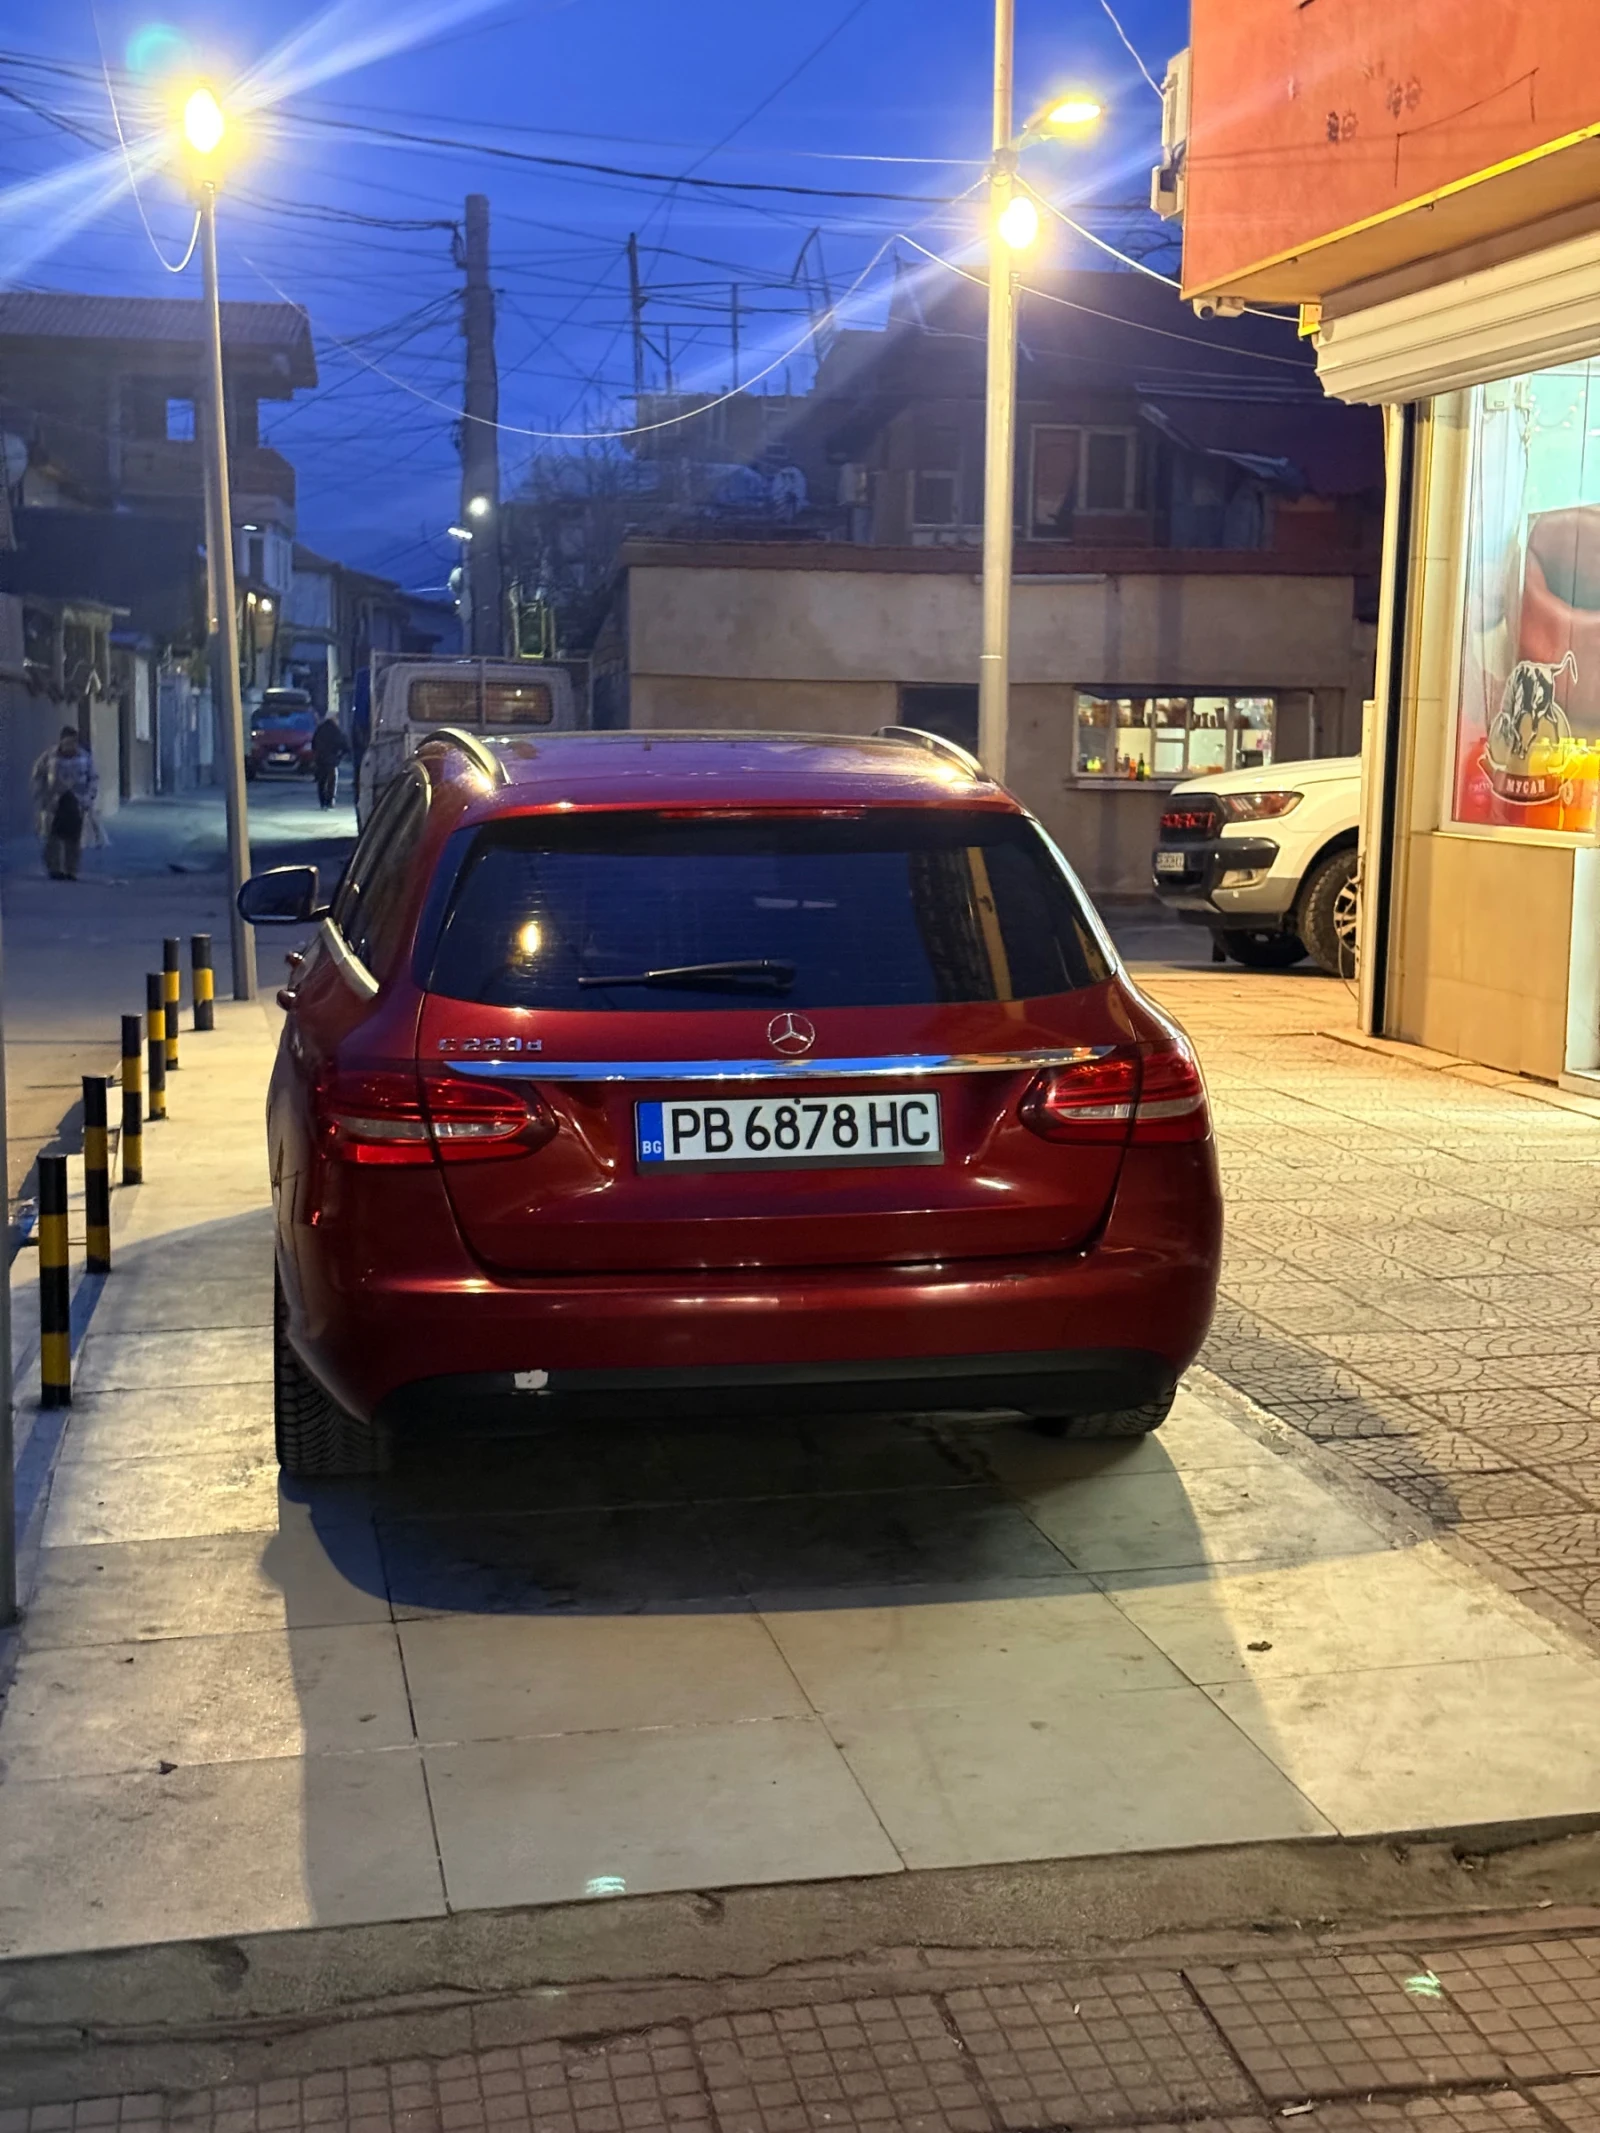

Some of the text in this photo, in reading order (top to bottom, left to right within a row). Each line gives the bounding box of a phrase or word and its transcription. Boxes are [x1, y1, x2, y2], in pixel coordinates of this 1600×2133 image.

[671, 1101, 931, 1154] PB 6878 HC
[641, 1140, 662, 1155] BG
